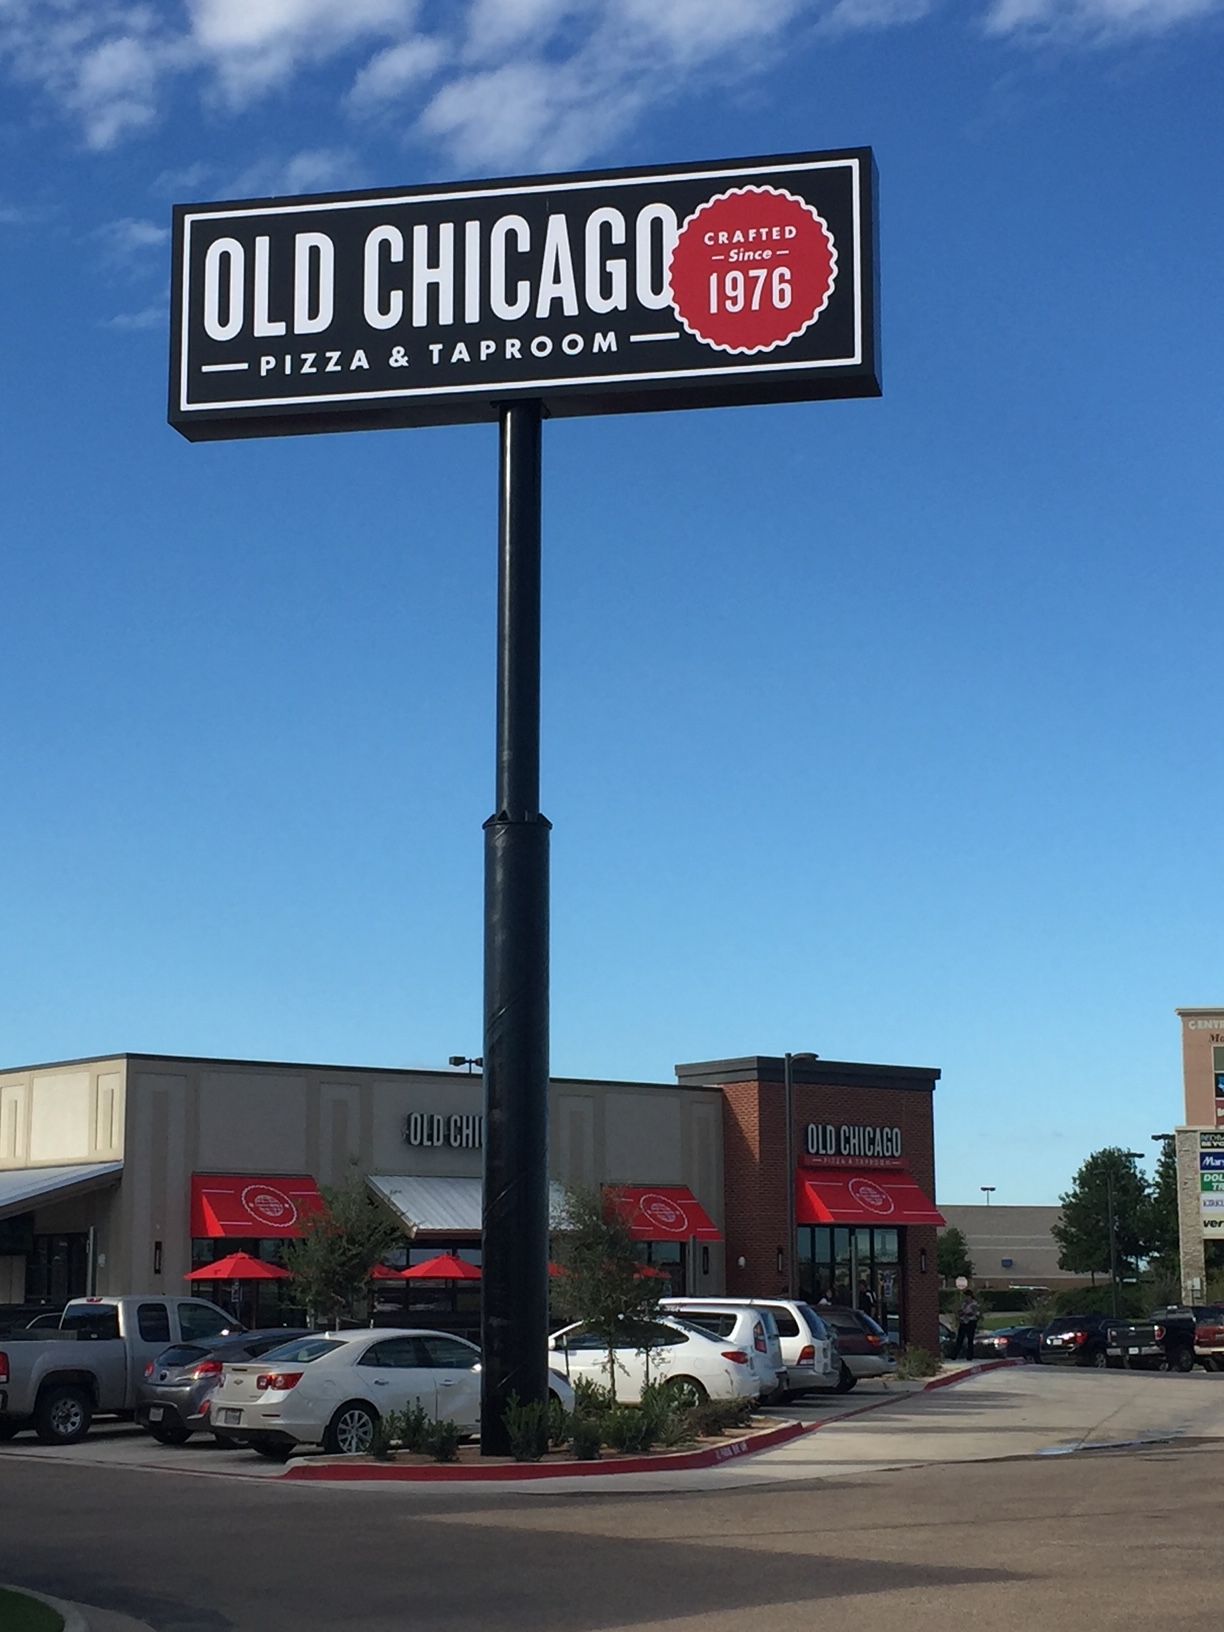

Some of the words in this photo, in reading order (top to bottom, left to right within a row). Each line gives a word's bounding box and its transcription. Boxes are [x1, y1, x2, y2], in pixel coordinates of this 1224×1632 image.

[704, 225, 797, 246] CRAFTED
[203, 232, 335, 341] OLD
[363, 202, 677, 330] CHICAGO
[728, 247, 773, 262] Since
[709, 266, 792, 314] 1976
[260, 349, 370, 377] PIZZA
[388, 345, 409, 368] &
[428, 331, 618, 365] TAPROOM
[410, 1112, 443, 1146] OLD
[450, 1114, 484, 1148] CHI
[807, 1123, 836, 1155] OLD
[840, 1124, 901, 1157] CHICAGO
